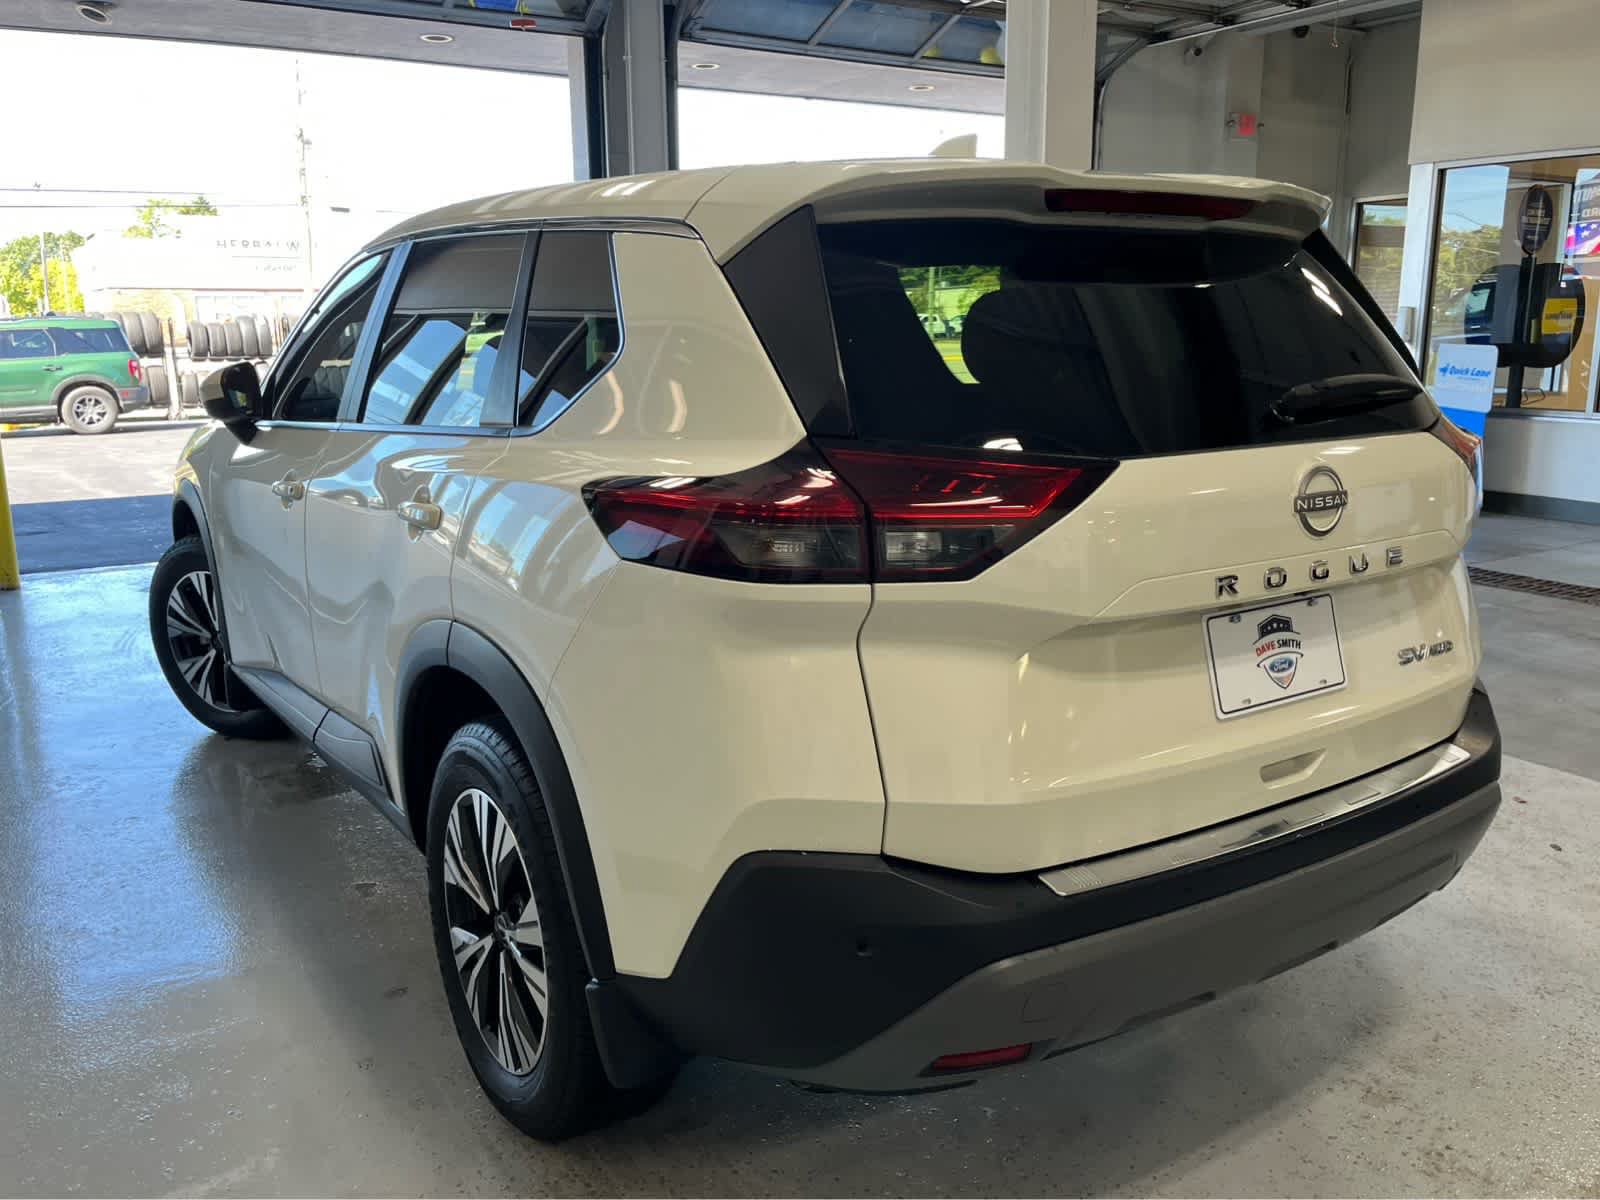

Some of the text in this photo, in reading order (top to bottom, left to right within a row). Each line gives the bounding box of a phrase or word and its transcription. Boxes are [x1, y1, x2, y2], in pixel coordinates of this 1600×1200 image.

[1297, 494, 1348, 511] NISSAN
[1215, 546, 1404, 597] ROGUE
[1255, 638, 1301, 657] DAVE SMITH
[1271, 658, 1291, 672] Ford
